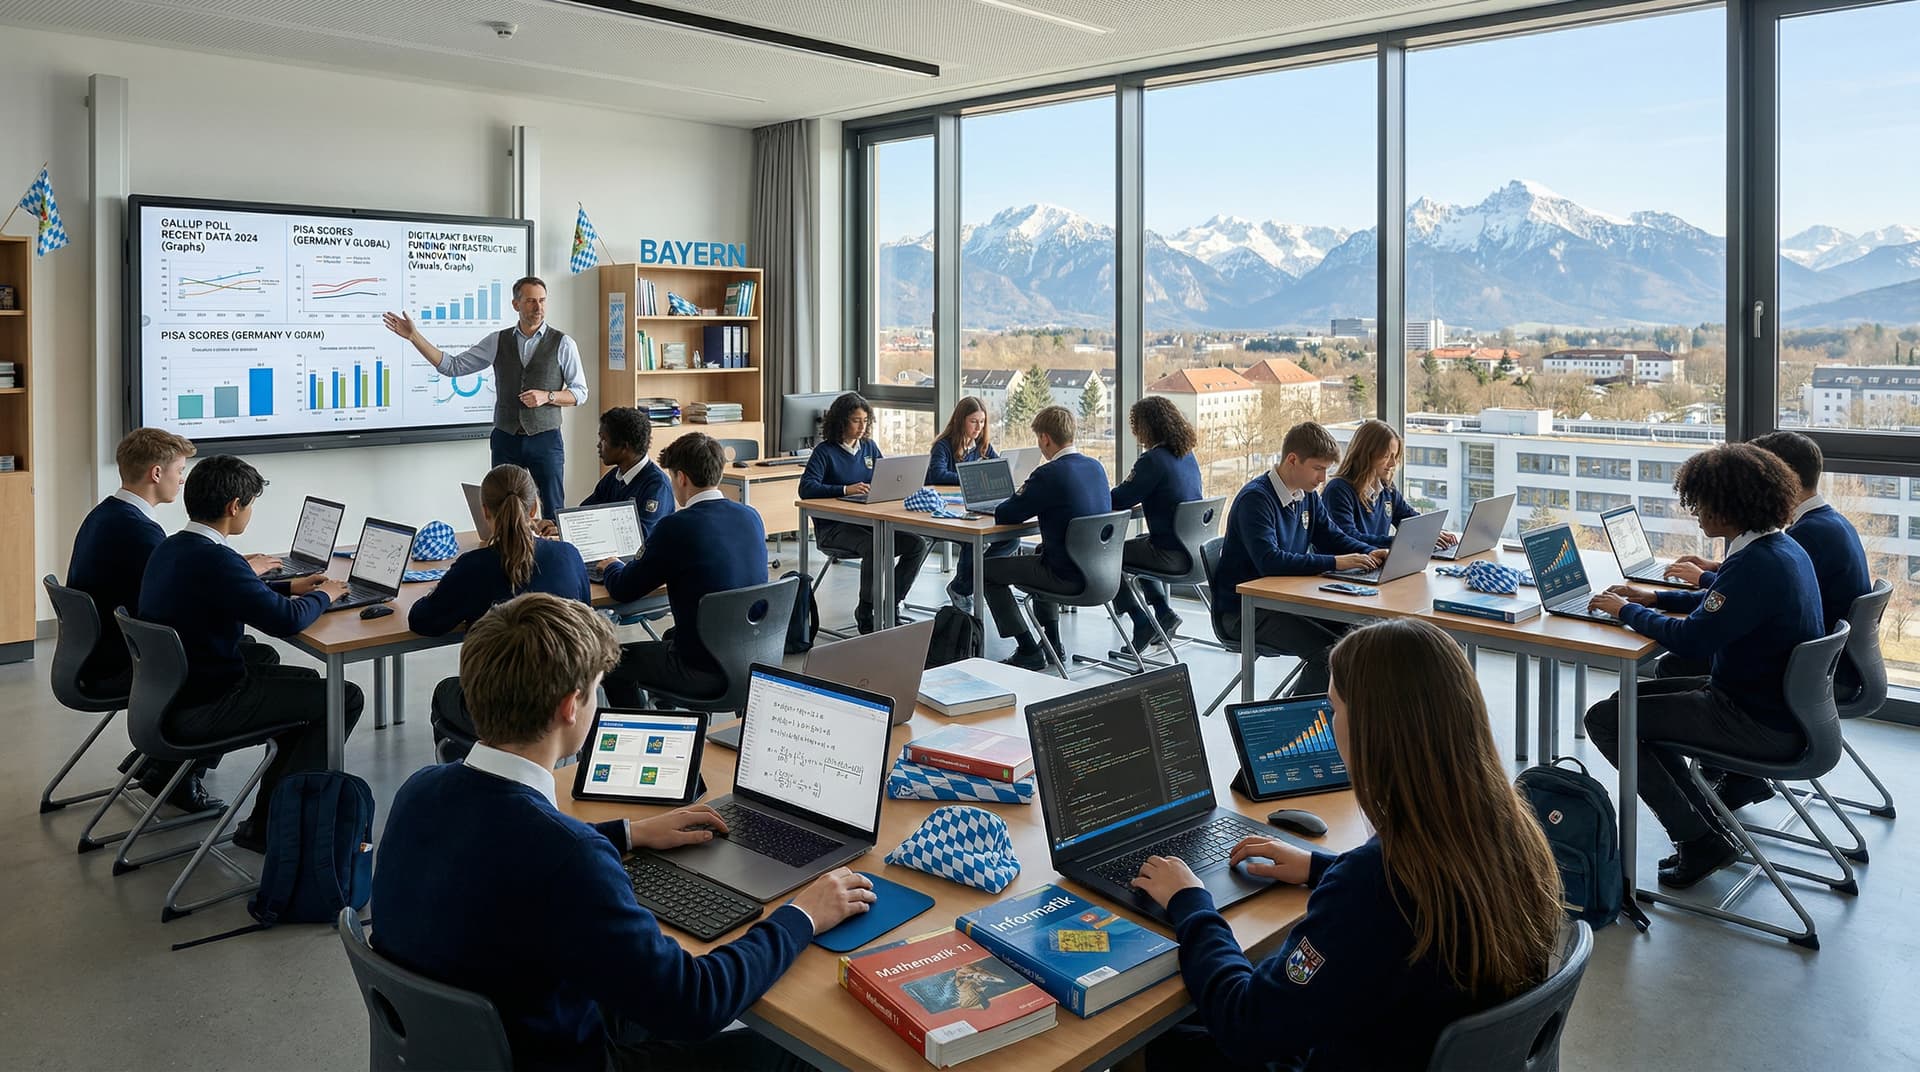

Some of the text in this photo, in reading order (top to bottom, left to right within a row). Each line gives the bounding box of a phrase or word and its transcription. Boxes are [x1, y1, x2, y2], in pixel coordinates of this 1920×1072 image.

[161, 218, 231, 230] GALLUP POLL
[161, 230, 258, 242] RECENT DATA 2024
[293, 225, 353, 236] PISA SCORES
[293, 235, 390, 249] (GERMANY V GLOBAL)
[408, 231, 493, 243] DIGITALPAKT BAYERN
[161, 241, 205, 253] (Graphs)
[408, 251, 467, 261] & INNOVATION
[640, 239, 747, 268] BAYERN
[161, 331, 186, 340] PISA
[188, 331, 229, 340] SCORES
[231, 330, 283, 341] (GERMANY
[285, 331, 292, 339] V
[990, 895, 1076, 933] Informatik
[875, 943, 973, 979] Mathematik 11
